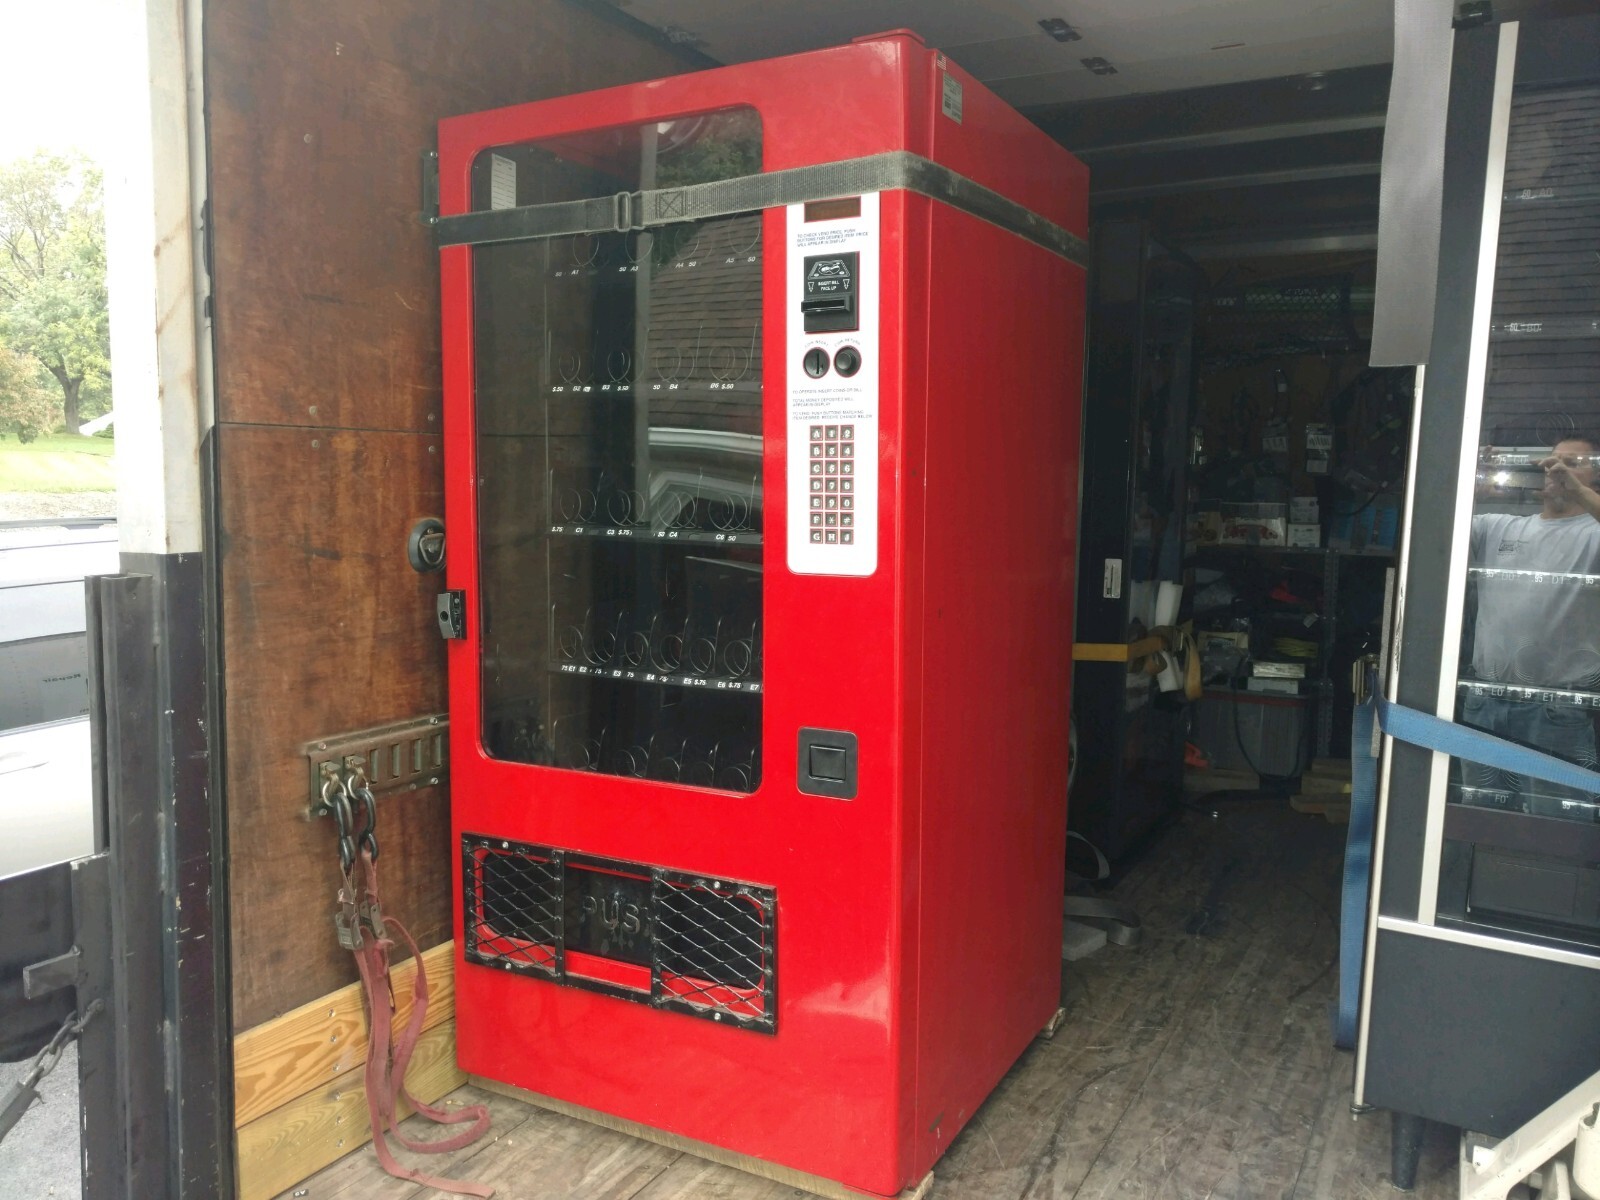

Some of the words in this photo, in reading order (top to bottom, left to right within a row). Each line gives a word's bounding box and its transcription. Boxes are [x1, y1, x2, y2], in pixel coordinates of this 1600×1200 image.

[1552, 575, 1564, 584] D1
[683, 677, 692, 685] E5
[1543, 692, 1554, 702] E1
